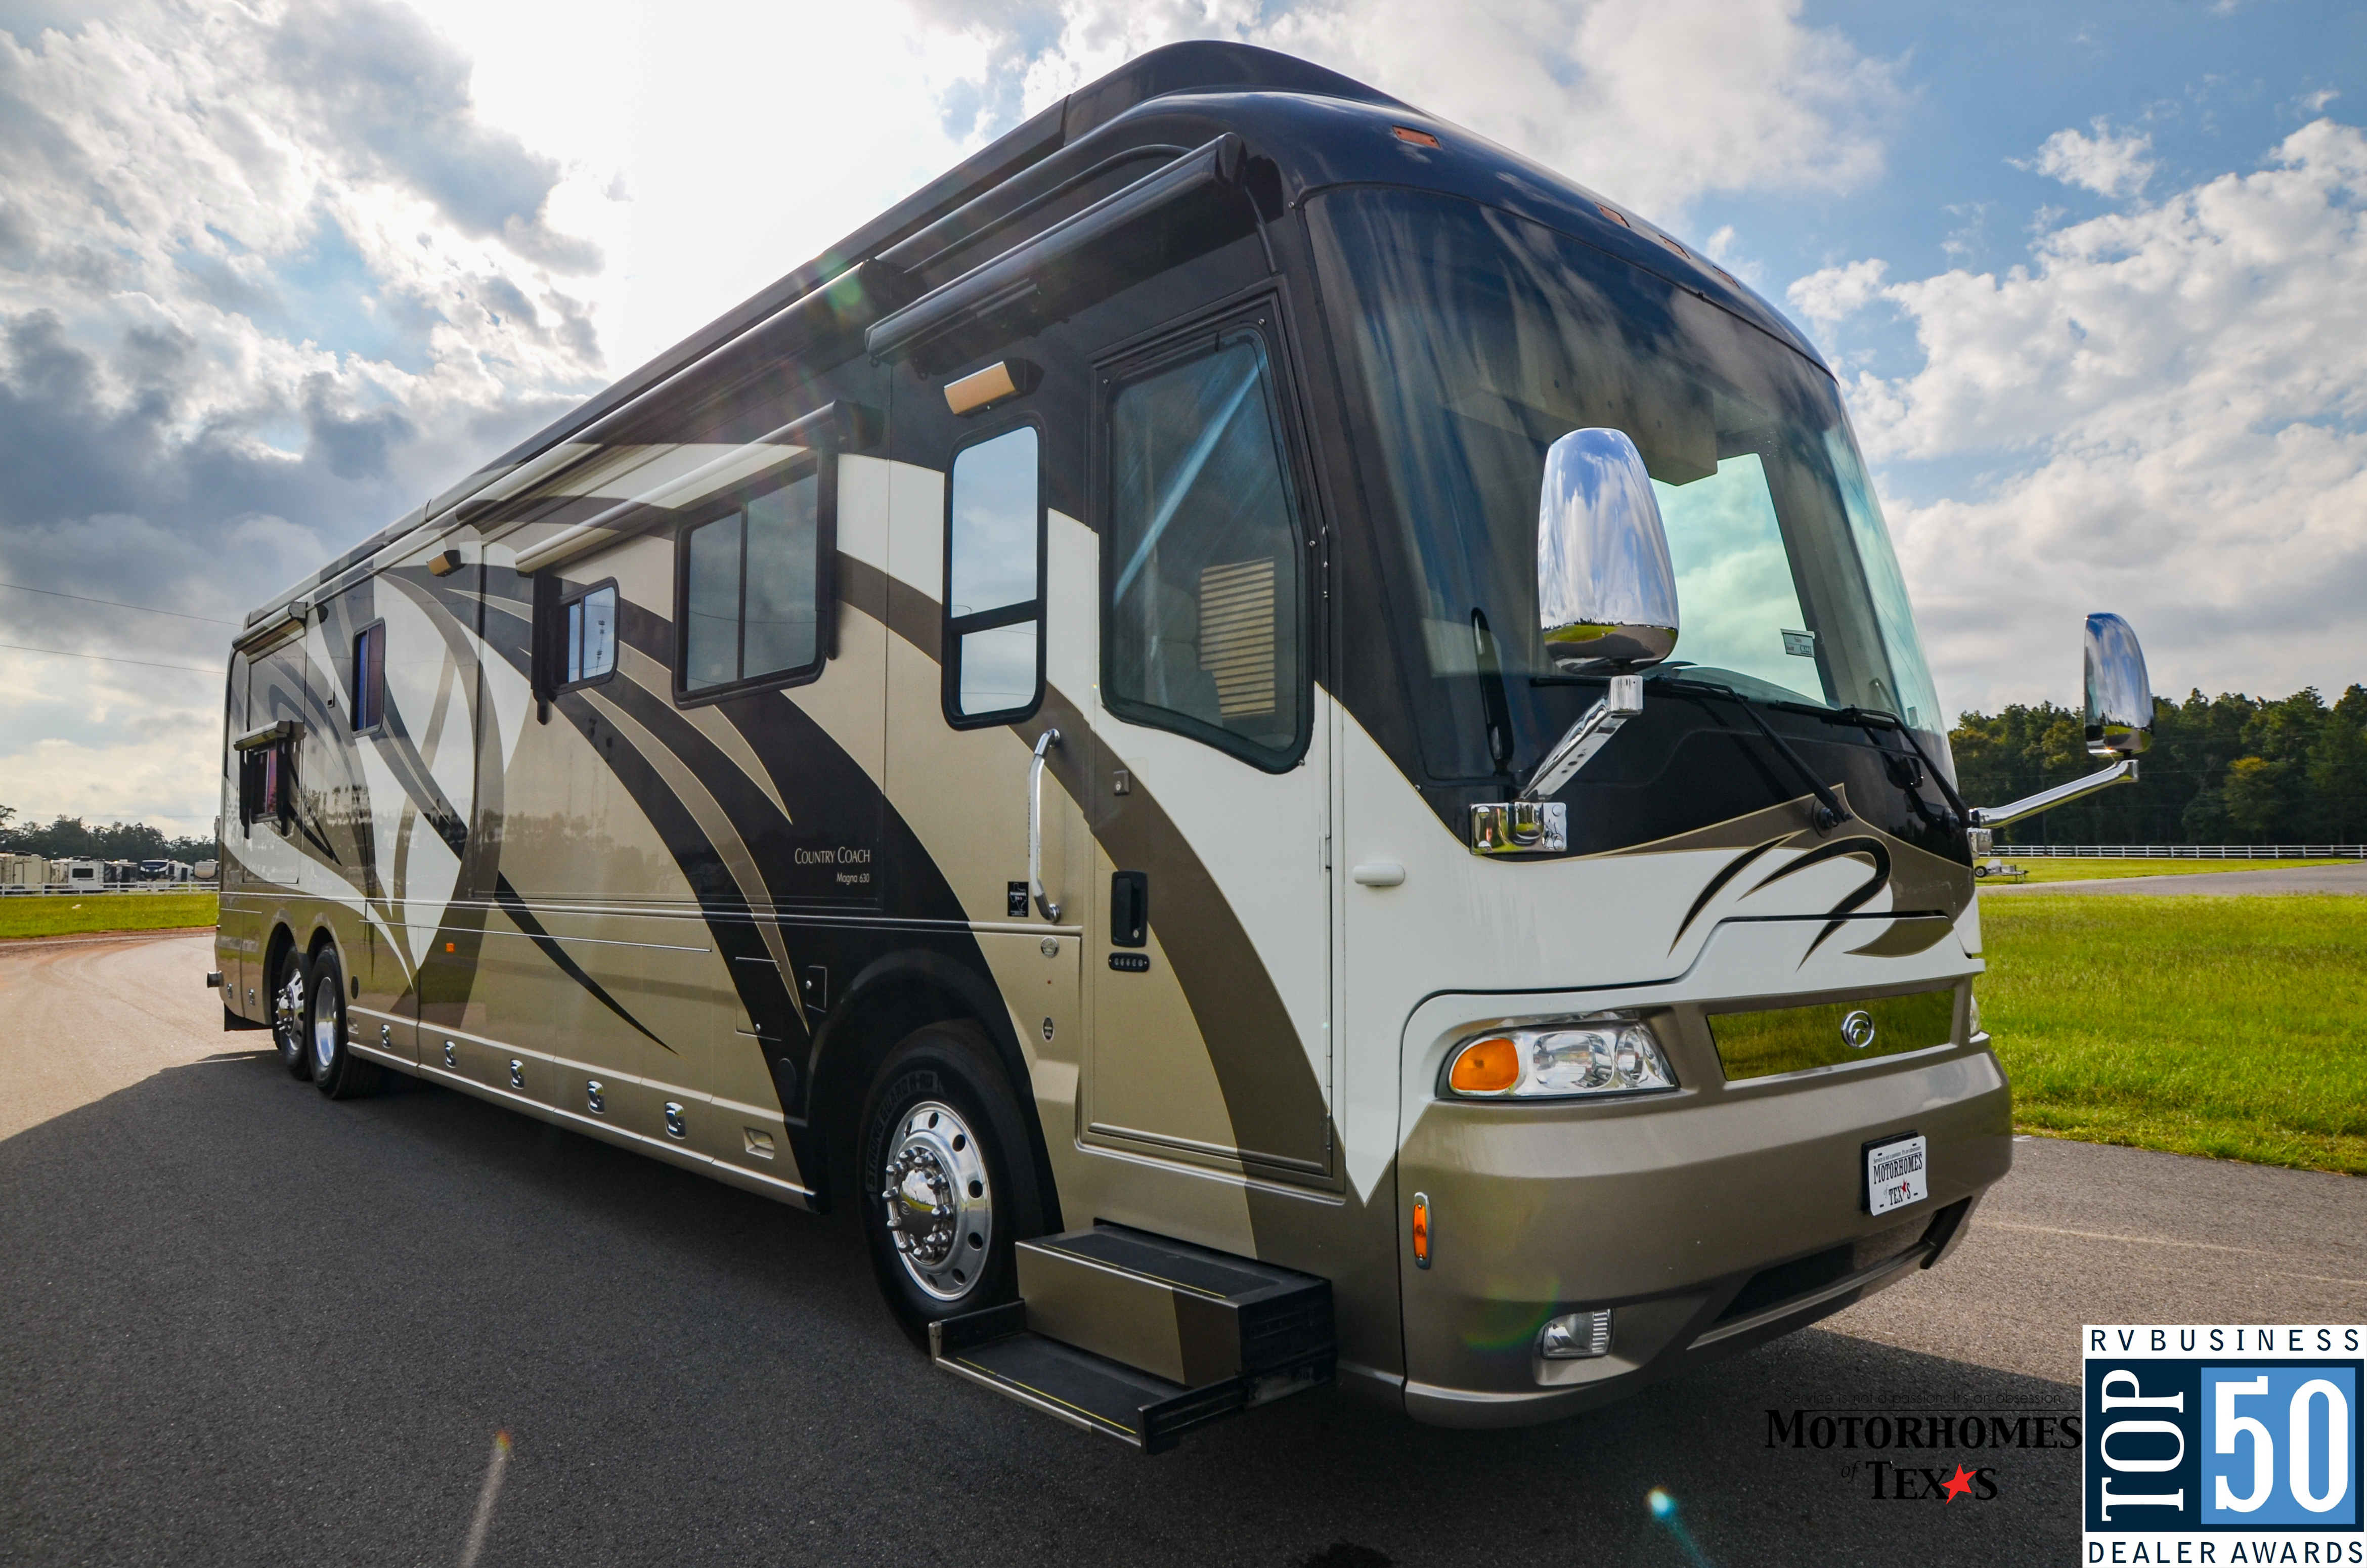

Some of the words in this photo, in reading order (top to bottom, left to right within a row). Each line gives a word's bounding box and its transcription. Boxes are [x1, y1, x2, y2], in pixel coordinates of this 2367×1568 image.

[795, 848, 835, 864] COUNTRY
[838, 846, 870, 863] COACH
[837, 872, 858, 885] Magna
[859, 873, 869, 883] 630
[1873, 1153, 1922, 1184] MOTORHOMES
